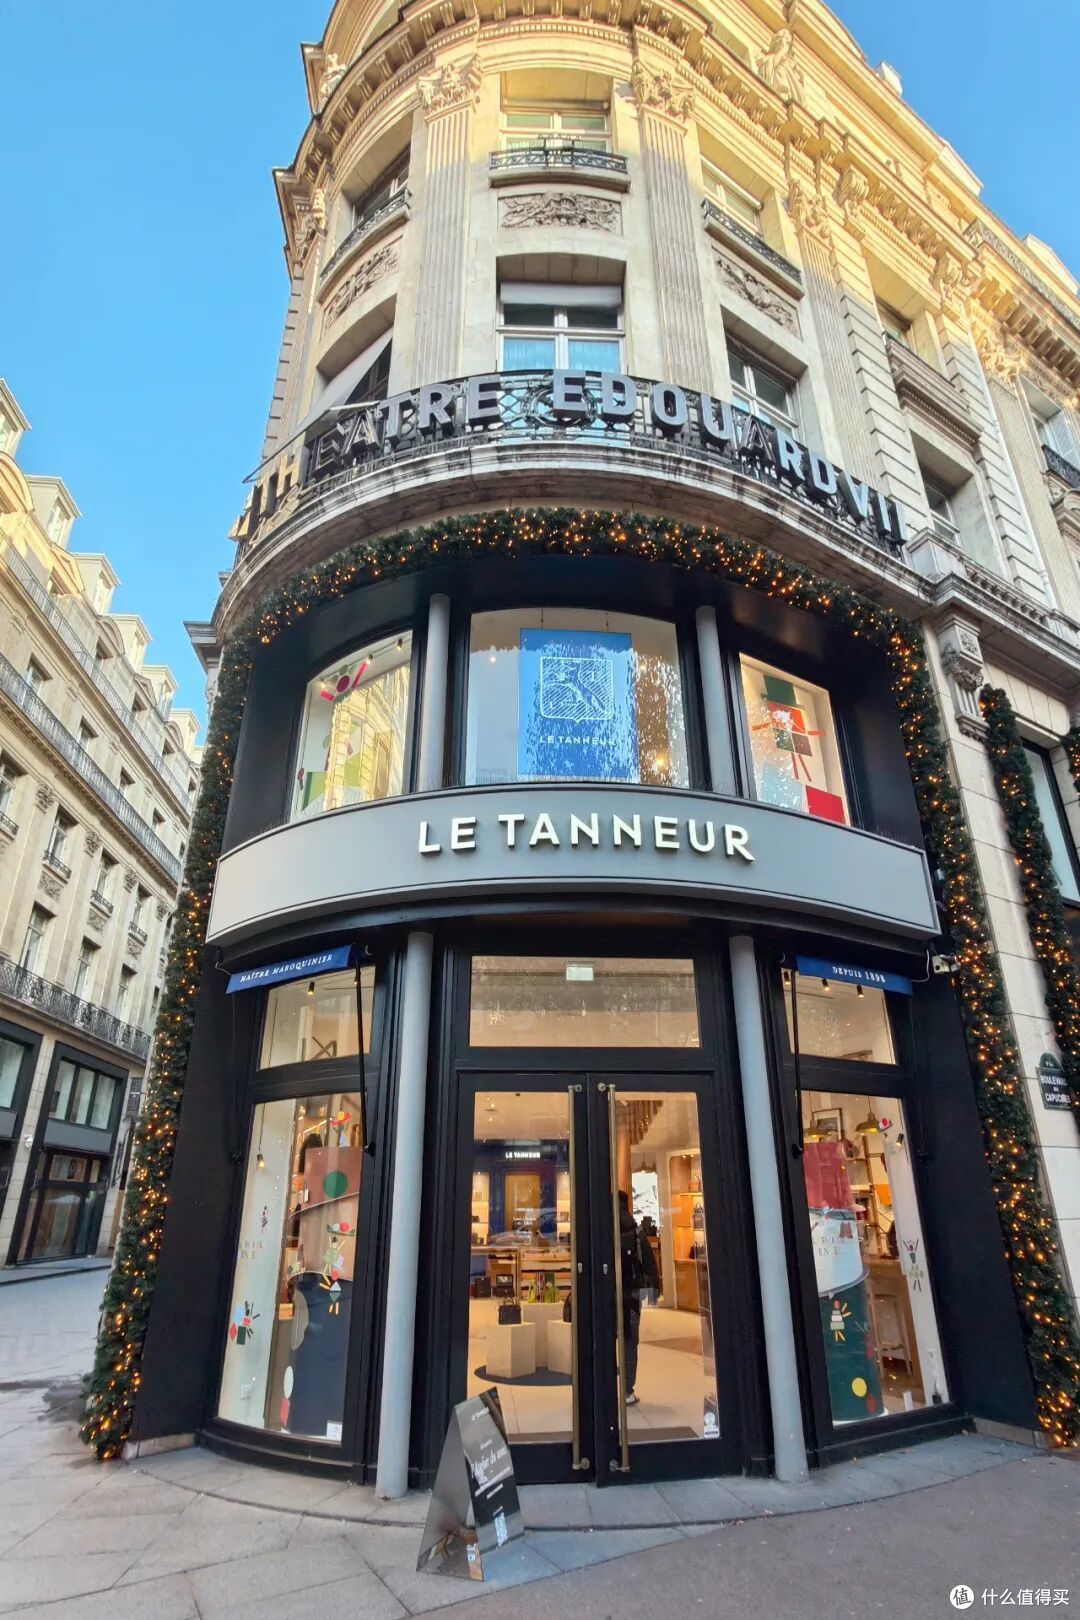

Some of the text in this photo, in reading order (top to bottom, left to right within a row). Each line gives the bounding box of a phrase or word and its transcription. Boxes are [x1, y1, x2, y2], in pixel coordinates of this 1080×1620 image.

[552, 368, 838, 496] EDOUARD
[540, 735, 616, 746] LE TANNEUR
[418, 812, 755, 862] LE TANNEUR
[272, 953, 333, 974] MAROQUINIER
[832, 966, 862, 978] DEPUIS
